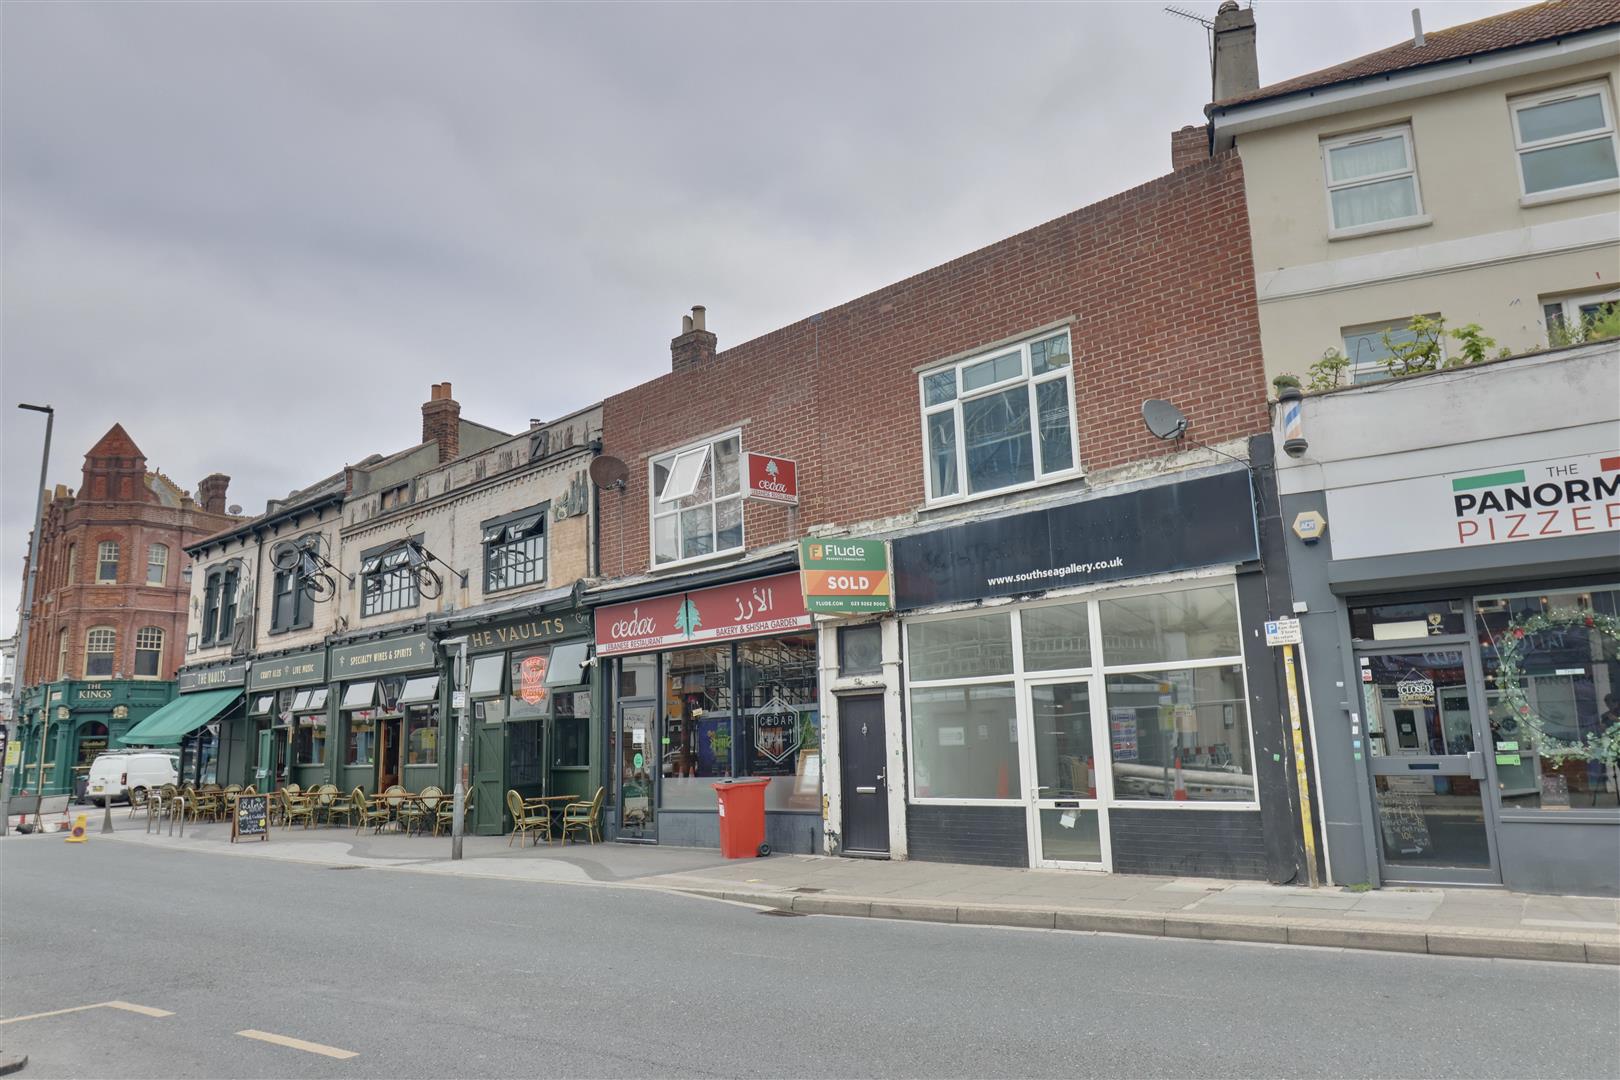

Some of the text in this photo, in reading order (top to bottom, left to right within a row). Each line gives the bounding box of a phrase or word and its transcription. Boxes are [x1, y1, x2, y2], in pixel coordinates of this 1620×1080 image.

[1546, 463, 1578, 477] THE
[758, 476, 787, 493] cedar
[825, 544, 865, 557] Flude
[987, 556, 1124, 586] www.southseagallery.co.uk
[827, 576, 869, 590] SOLD
[734, 587, 773, 622] الأرز
[496, 618, 564, 643] VAULTS
[611, 607, 656, 639] cedar
[715, 617, 798, 637] BAKERY & SHISHA GARDEN
[605, 636, 663, 653] LEBANESE RESTAURANT
[350, 647, 412, 666] SPECIALTY WINES & SPIRITS
[198, 670, 226, 684] THE VAULTS
[260, 664, 314, 680] CRAFT ALES LIVE MUSIC
[79, 690, 112, 699] KINGS
[1400, 684, 1431, 695] CLOSED
[760, 715, 794, 727] CEDAR
